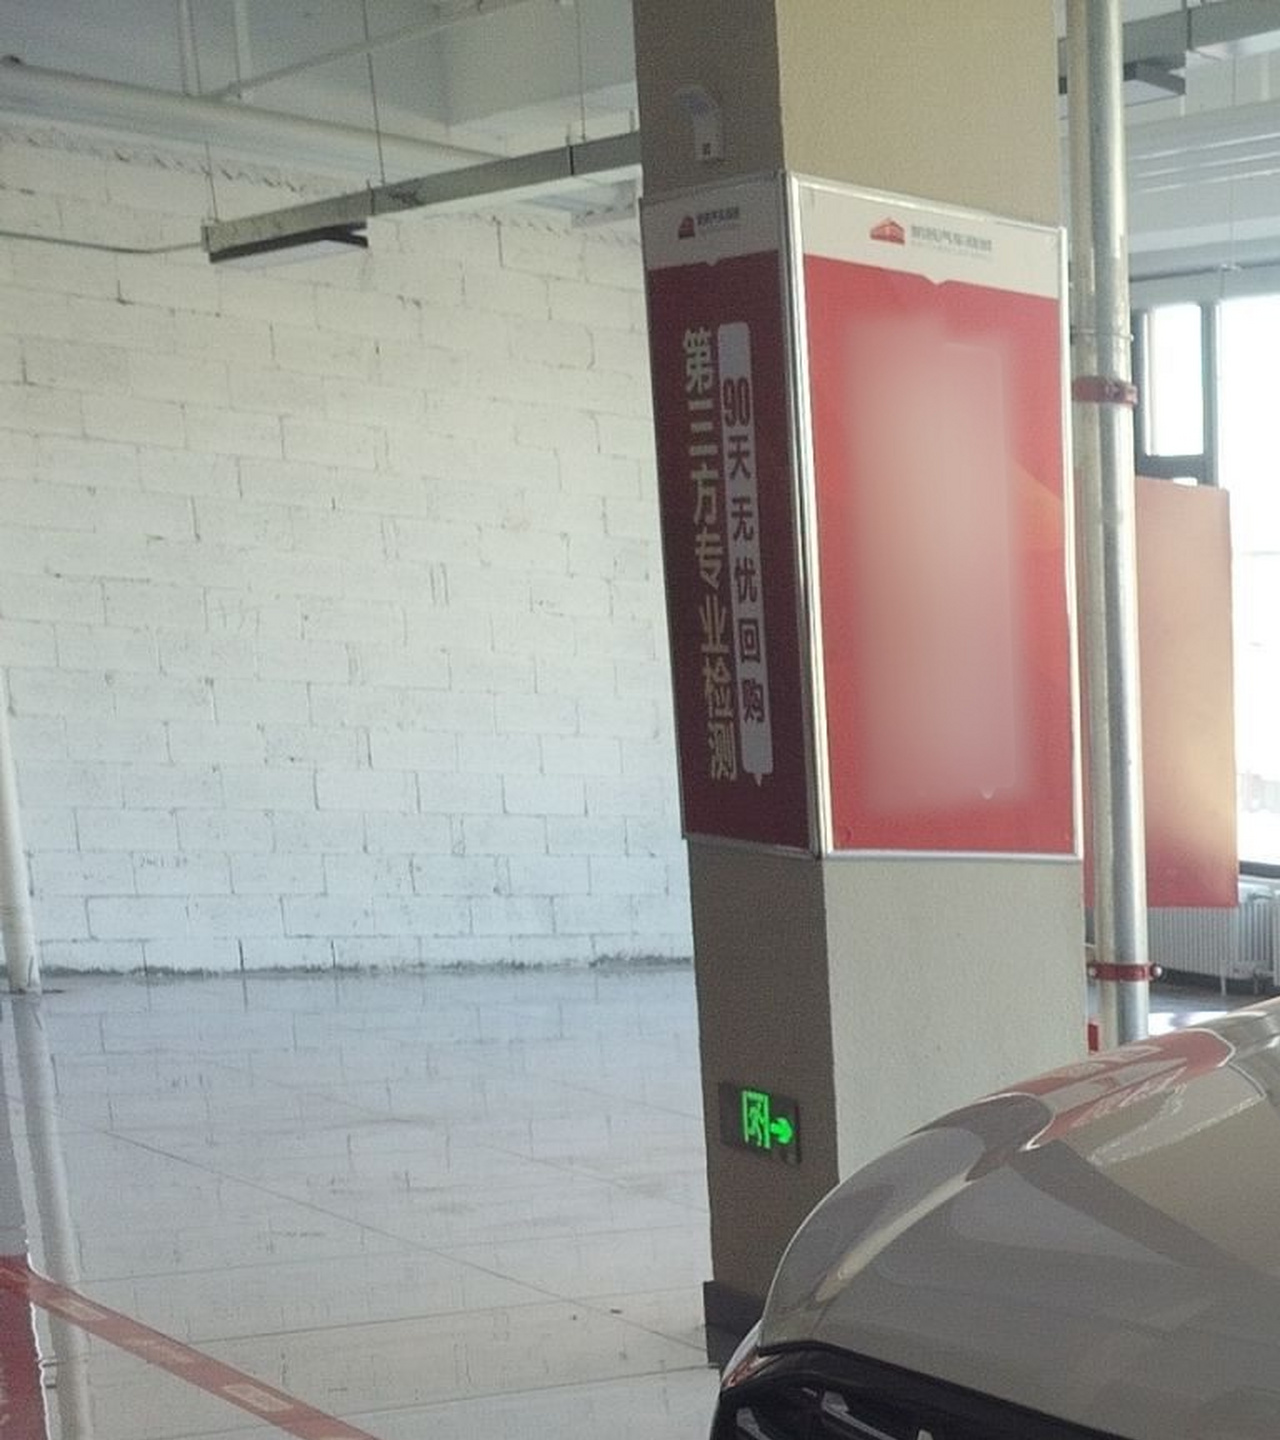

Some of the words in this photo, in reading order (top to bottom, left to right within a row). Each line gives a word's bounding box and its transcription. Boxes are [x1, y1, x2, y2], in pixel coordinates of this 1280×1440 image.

[683, 325, 738, 782] 第三方专业检测
